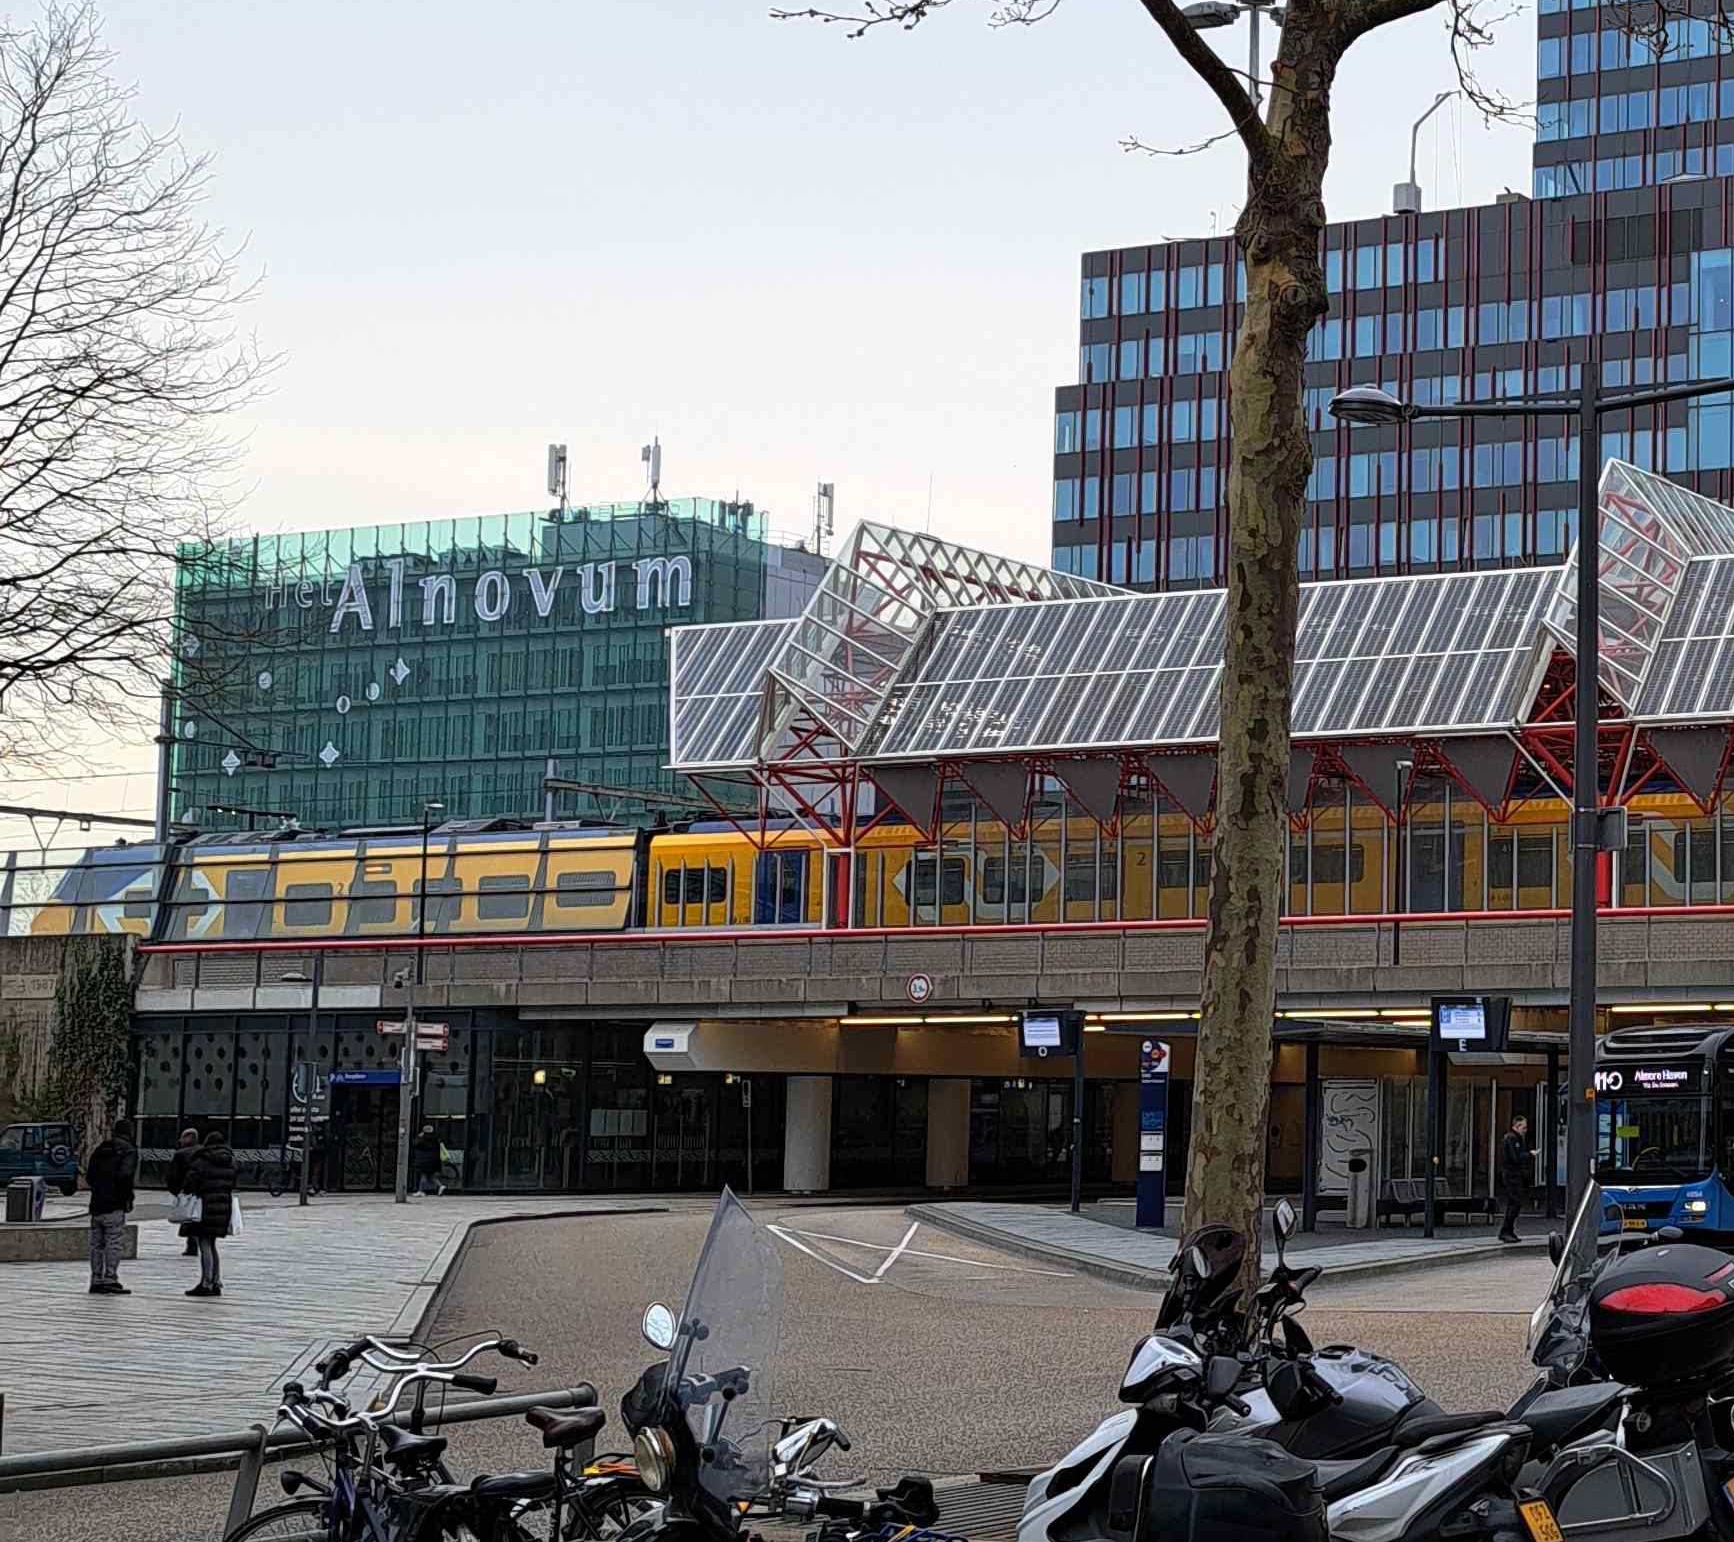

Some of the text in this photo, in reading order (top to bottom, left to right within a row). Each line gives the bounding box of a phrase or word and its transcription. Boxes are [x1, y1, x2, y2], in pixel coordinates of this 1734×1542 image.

[265, 555, 692, 633] Het Alnovum
[1136, 852, 1145, 866] 2
[1459, 1039, 1467, 1051] E
